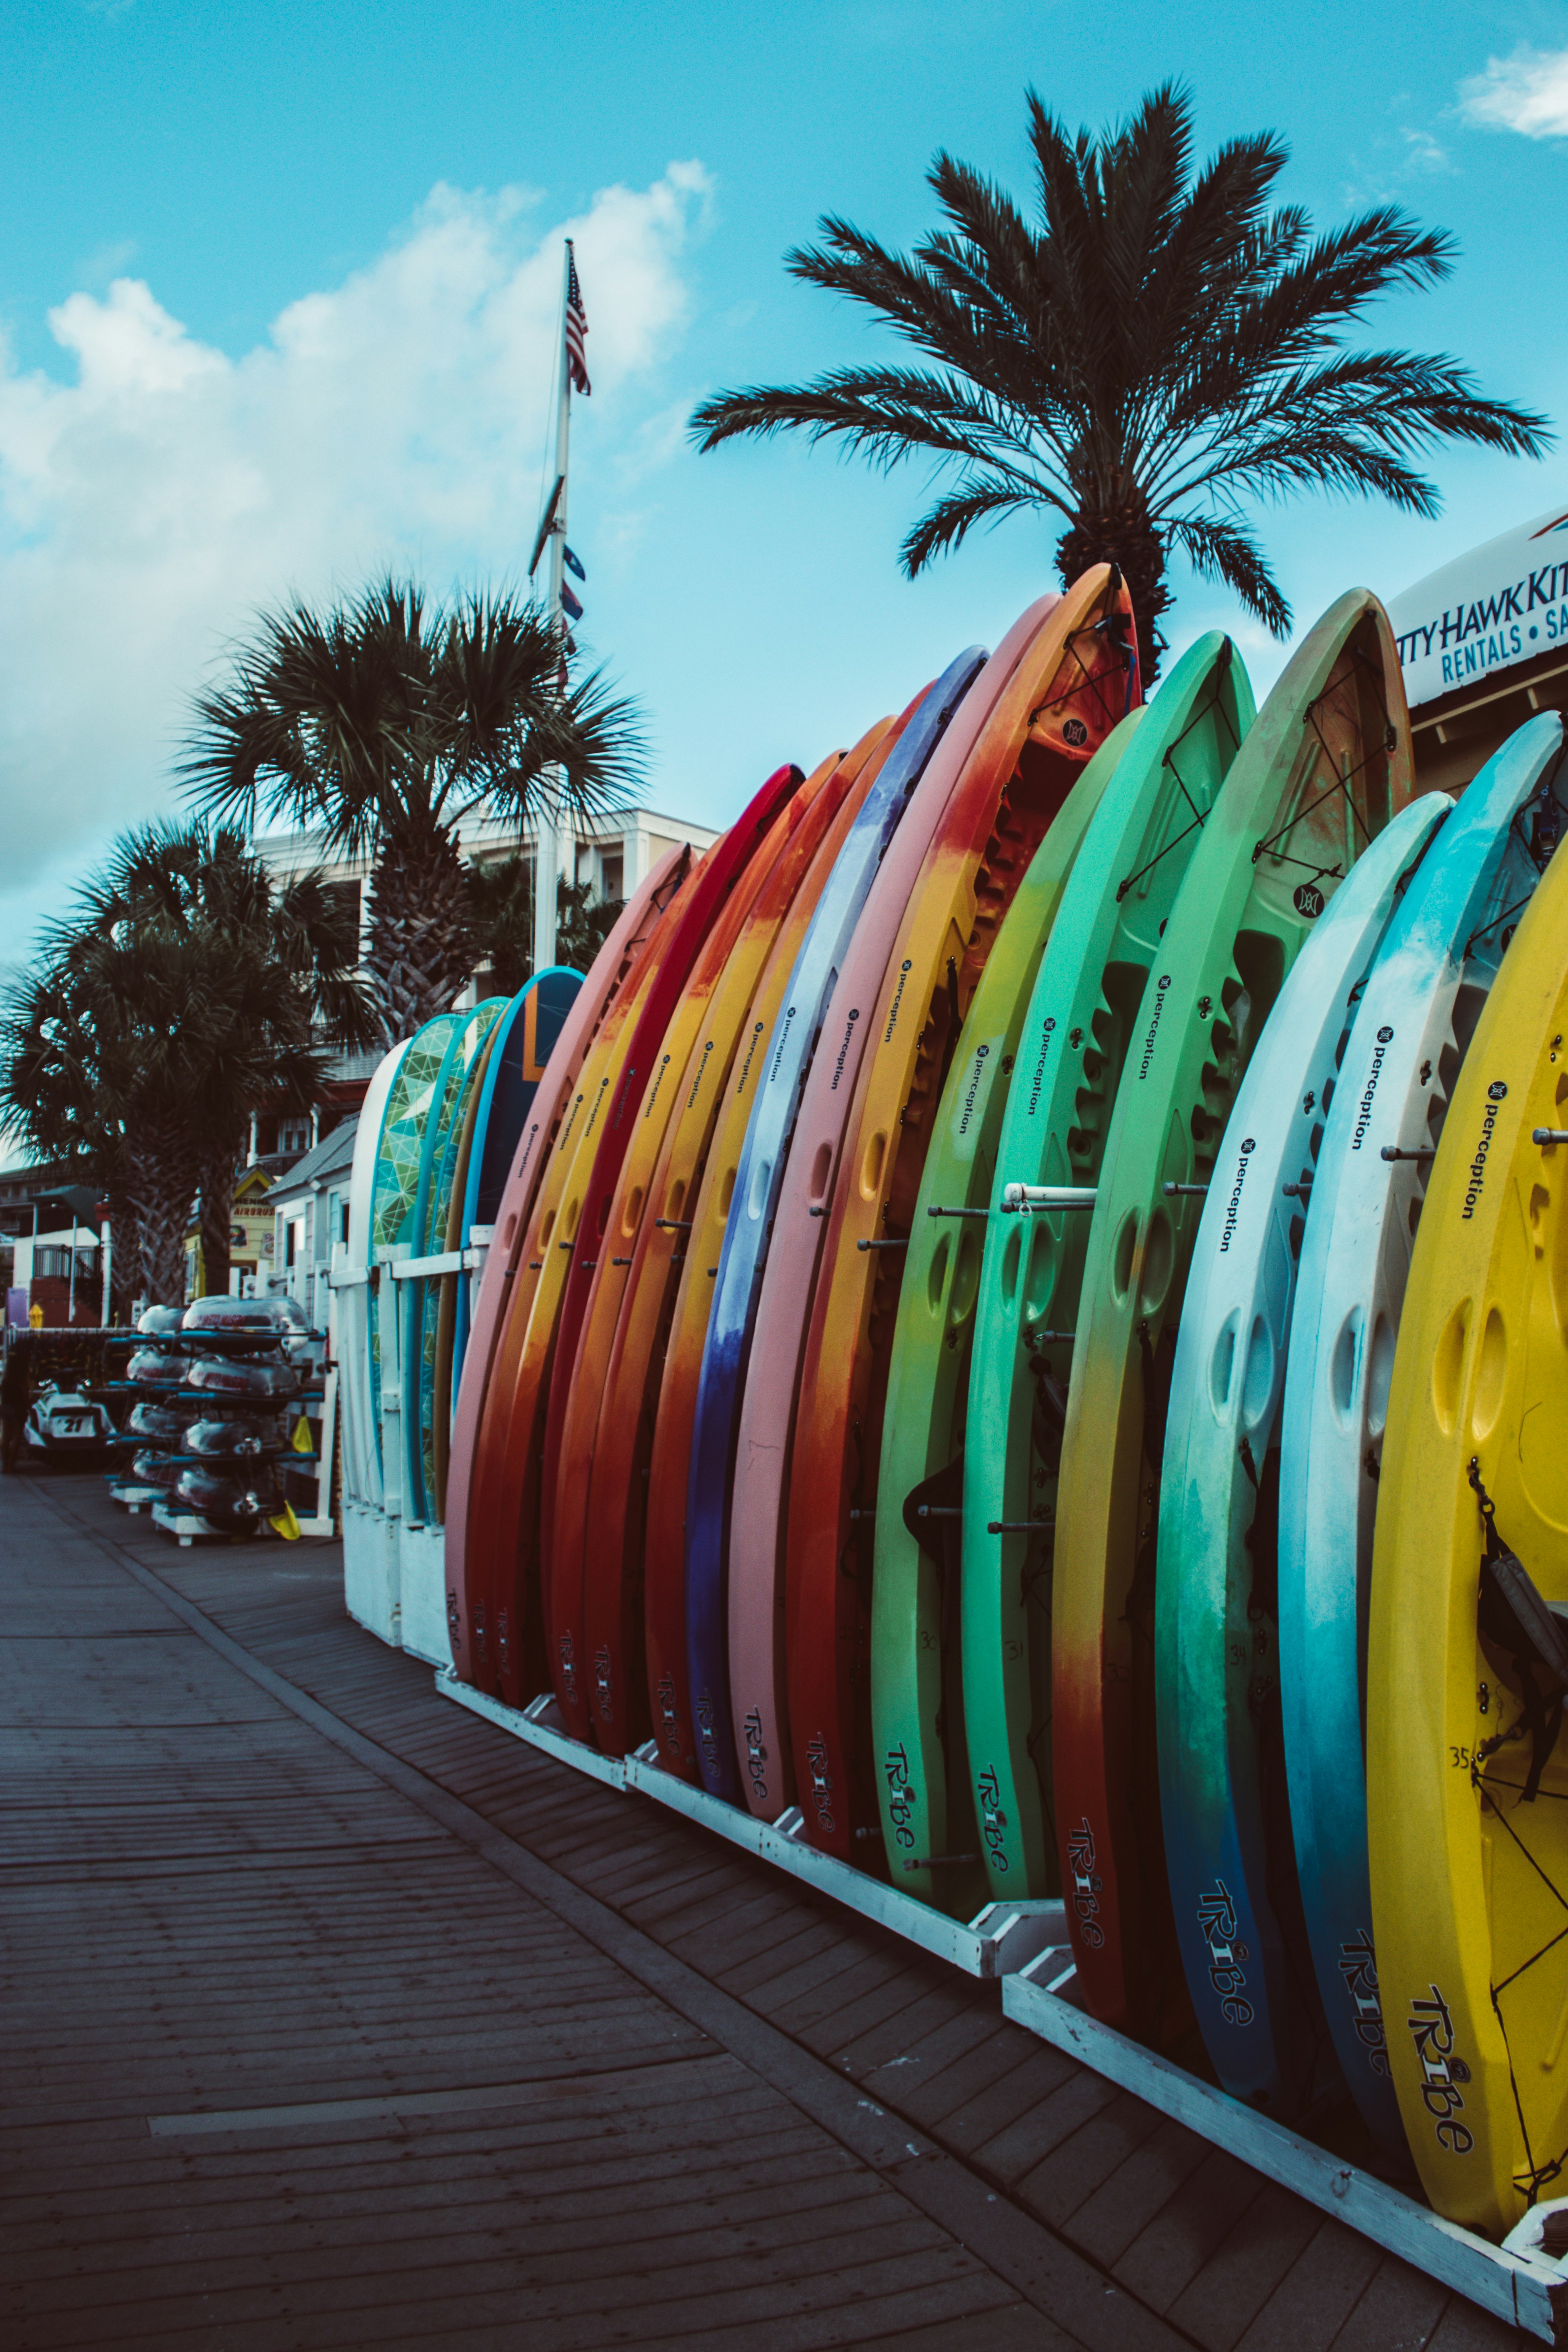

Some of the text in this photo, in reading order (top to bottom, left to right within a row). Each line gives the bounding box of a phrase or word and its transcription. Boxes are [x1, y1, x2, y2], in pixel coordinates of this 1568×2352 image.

[1439, 580, 1526, 650] HAWK
[1442, 624, 1522, 683] RENTALS
[884, 973, 907, 1043] perception
[1139, 993, 1165, 1080] perception
[688, 1051, 709, 1108] perception
[737, 1033, 759, 1093] perception
[770, 1018, 792, 1082] perception
[831, 1023, 853, 1090] perception
[1028, 1034, 1050, 1115] perception
[585, 1087, 604, 1136] perception
[645, 1064, 667, 1118] perception
[959, 1060, 983, 1134] perception
[1351, 1047, 1385, 1150] perception
[518, 1134, 535, 1178] perception
[560, 1104, 579, 1150] perception
[1462, 1104, 1498, 1220] perception
[1220, 1157, 1249, 1252] perception
[64, 1418, 82, 1432] 21
[921, 1631, 937, 1651] 30
[1005, 1639, 1024, 1661] 31
[1230, 1644, 1246, 1667] 34
[1450, 1746, 1469, 1769] 35
